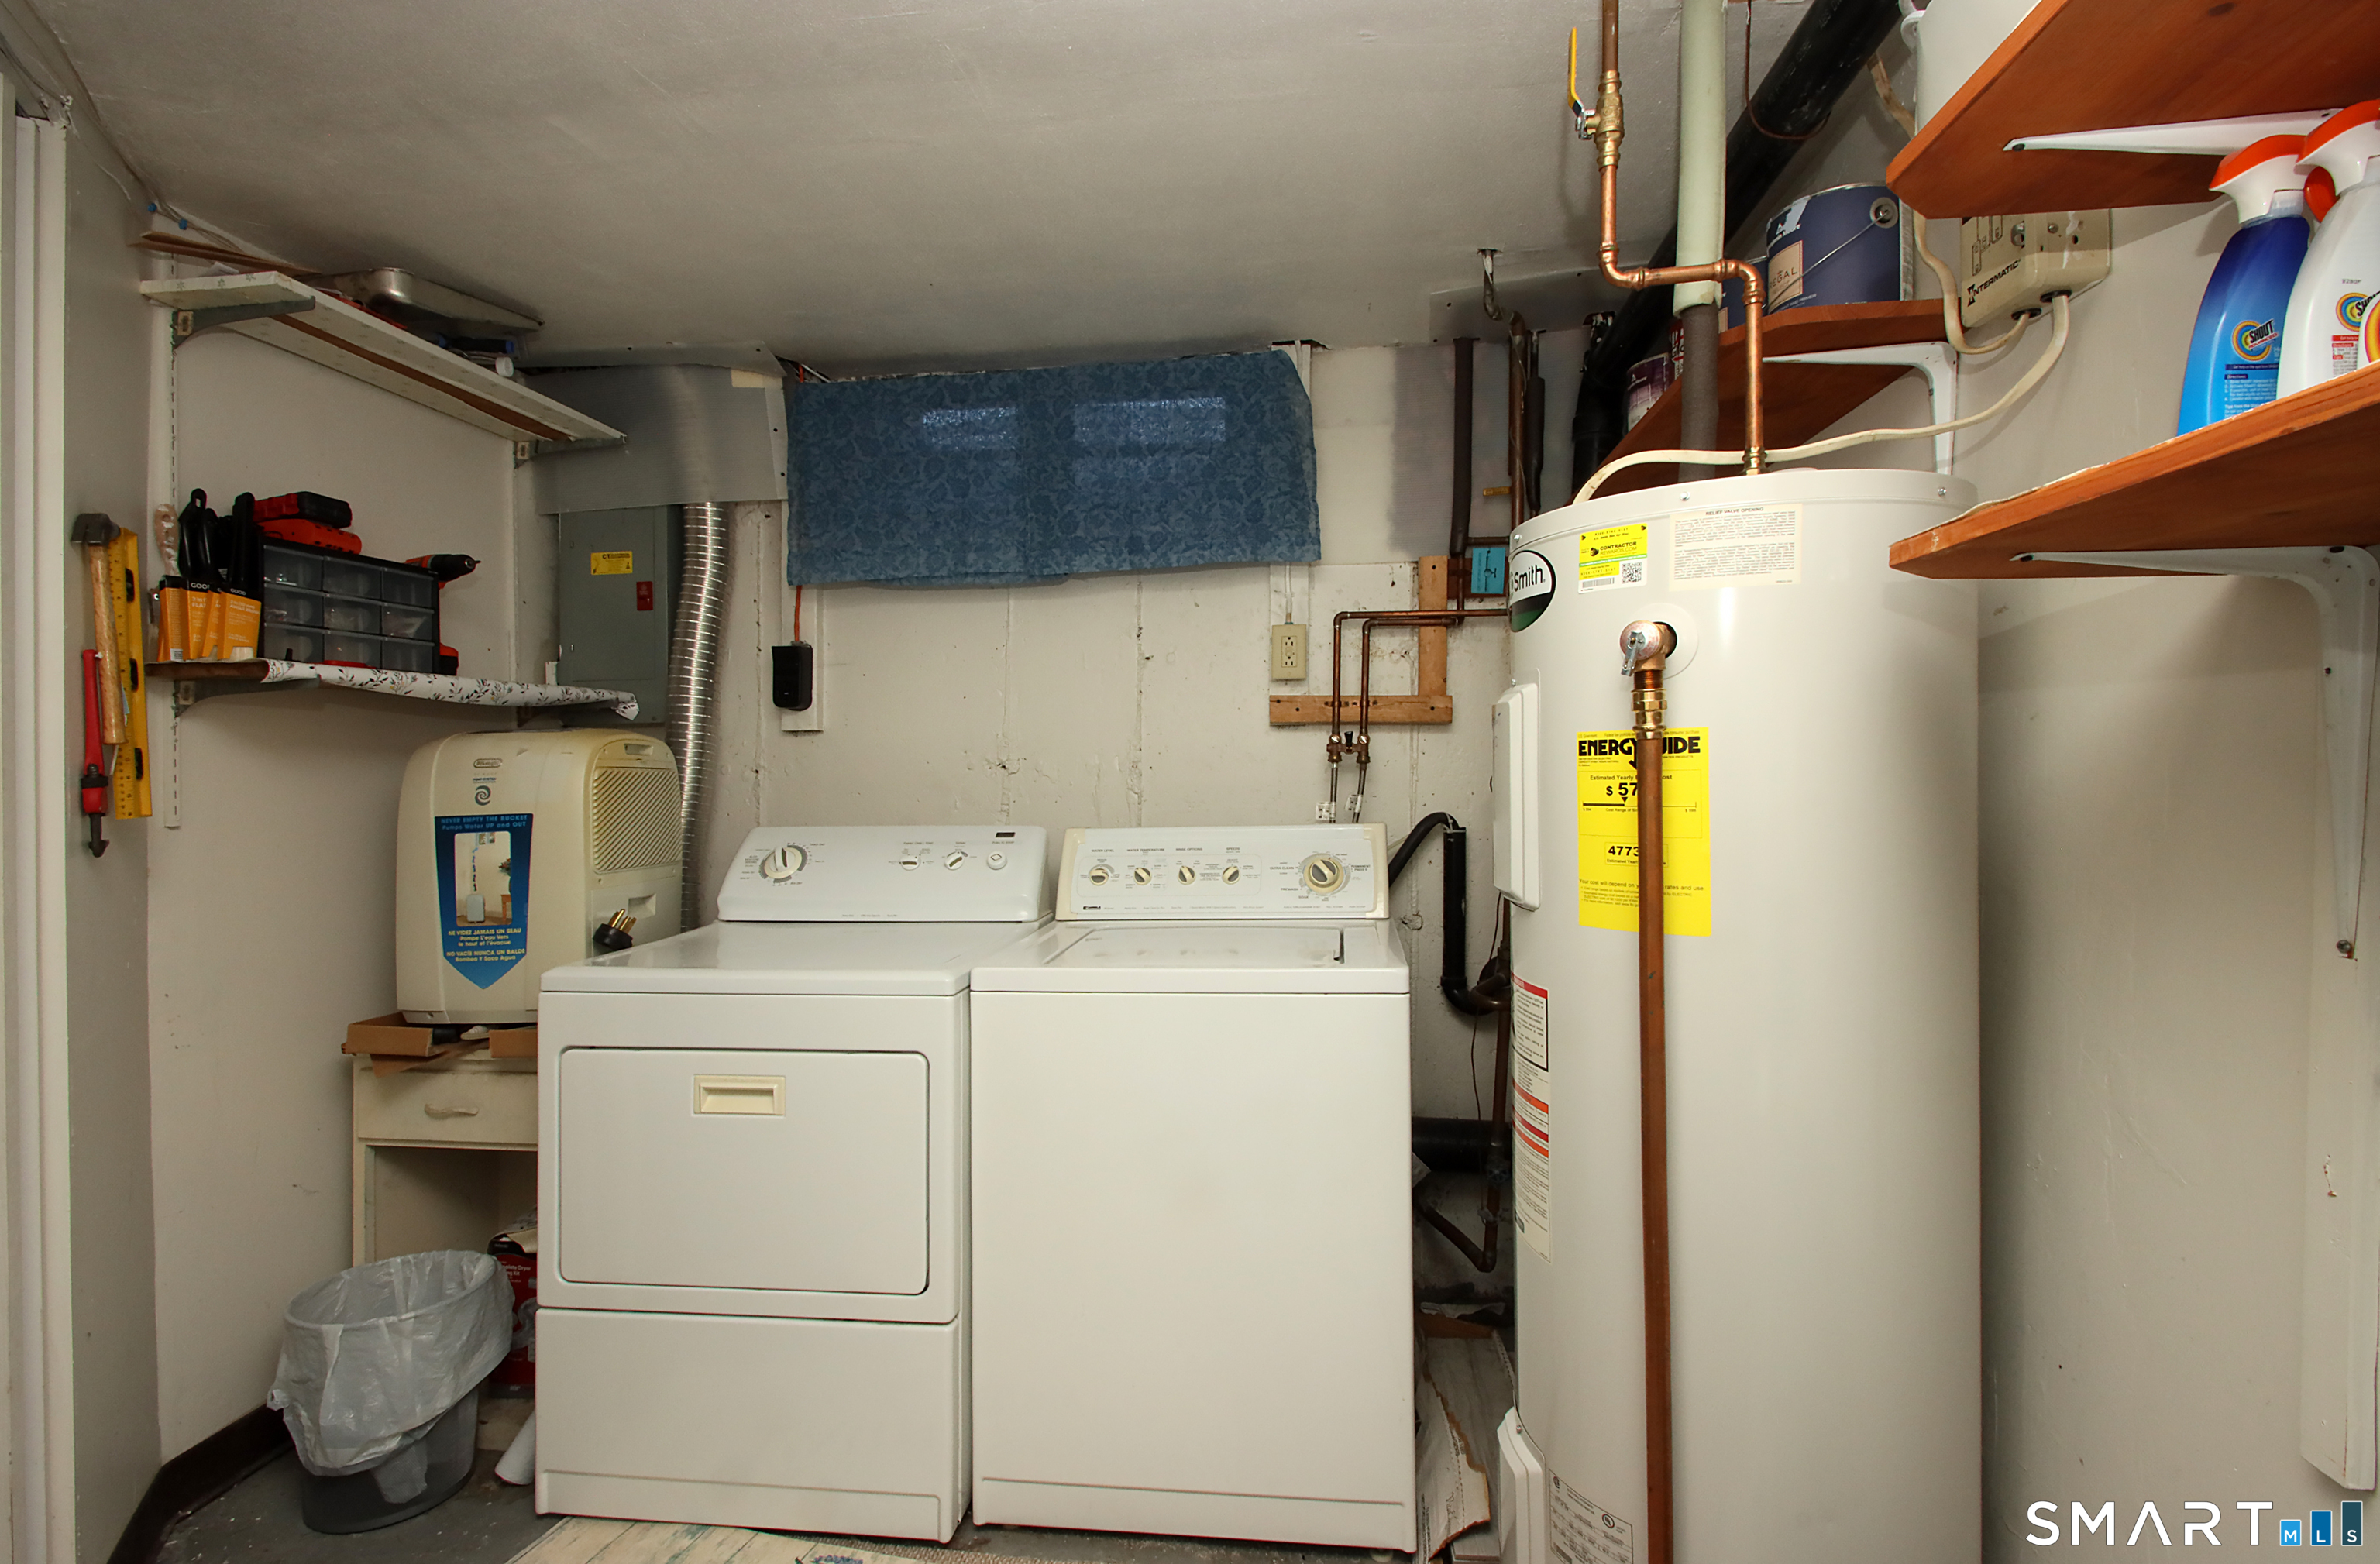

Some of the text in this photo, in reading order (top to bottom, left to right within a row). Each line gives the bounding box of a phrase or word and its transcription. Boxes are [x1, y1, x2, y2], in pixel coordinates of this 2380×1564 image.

[1967, 258, 2021, 307] INTERMATIC
[2249, 318, 2274, 343] SHOUT
[1600, 541, 1637, 551] CONTRACTOR
[1514, 564, 1545, 592] Smith
[1606, 782, 1639, 797] $ 57
